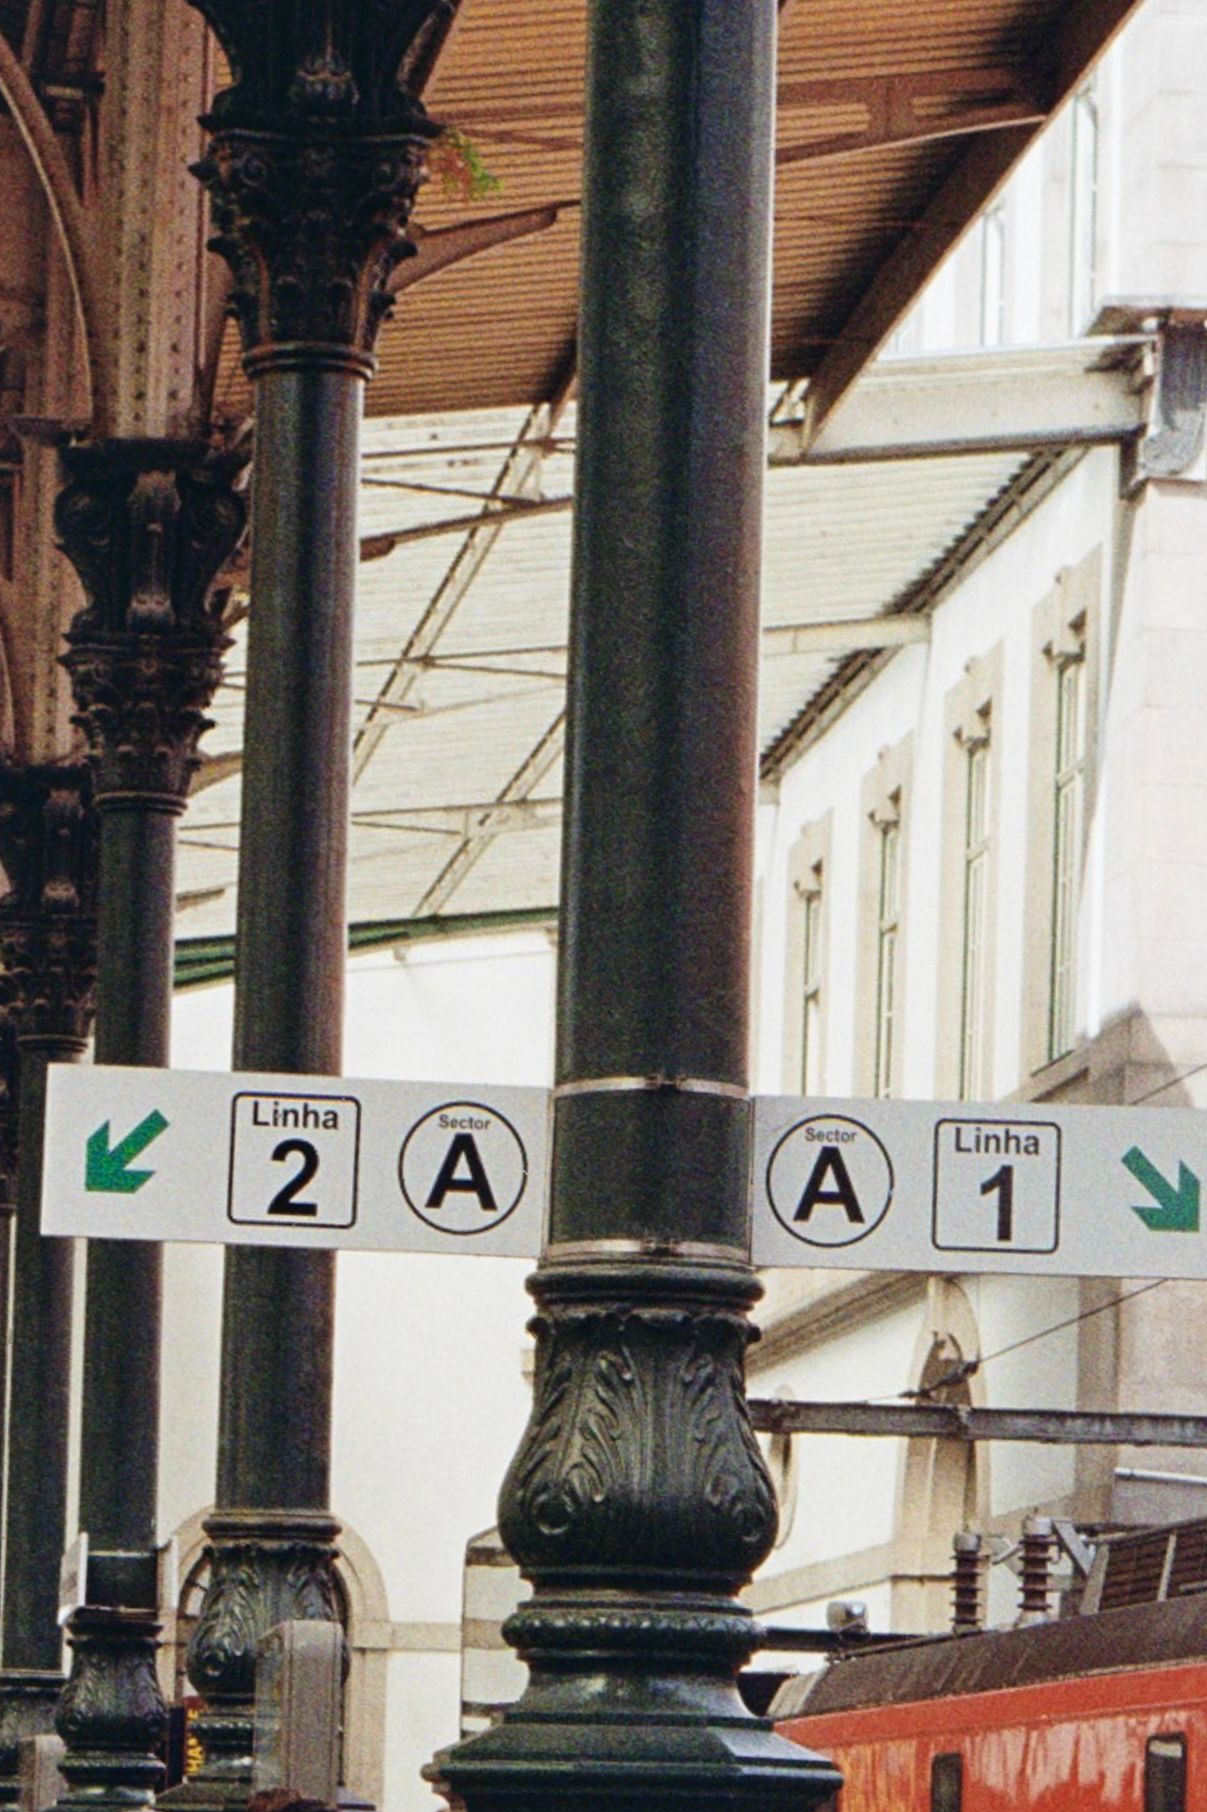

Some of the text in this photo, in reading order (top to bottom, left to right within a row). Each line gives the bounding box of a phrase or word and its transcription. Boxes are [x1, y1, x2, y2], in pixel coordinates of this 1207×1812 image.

[251, 1100, 339, 1131] Linha
[438, 1114, 491, 1131] Sector
[804, 1127, 858, 1144] Sector
[954, 1126, 1040, 1156] Linha
[266, 1138, 320, 1217] 2
[425, 1133, 498, 1212] A
[793, 1146, 865, 1224] A
[980, 1164, 1014, 1242] 1
